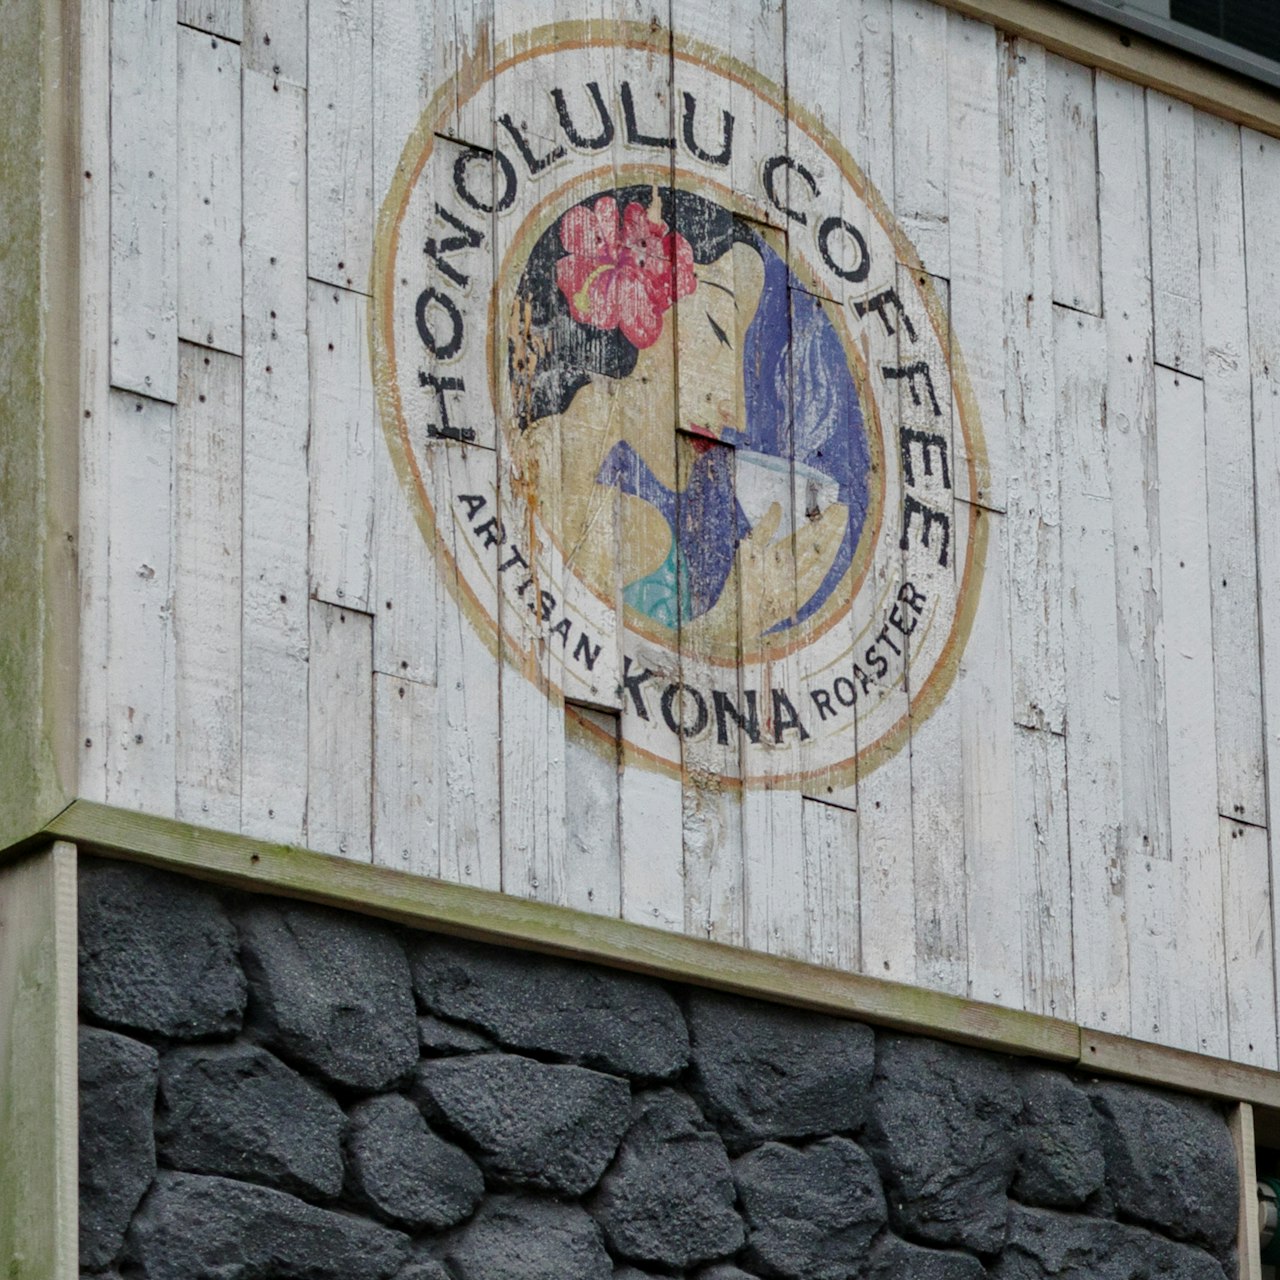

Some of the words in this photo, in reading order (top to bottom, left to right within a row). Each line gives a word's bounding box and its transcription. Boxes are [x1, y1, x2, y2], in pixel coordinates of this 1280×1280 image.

[414, 80, 735, 443] HONOLULU
[762, 152, 951, 569] COFFEE
[457, 490, 602, 680] ARTISAN
[621, 655, 808, 746] KONA
[811, 580, 929, 718] ROASTER
